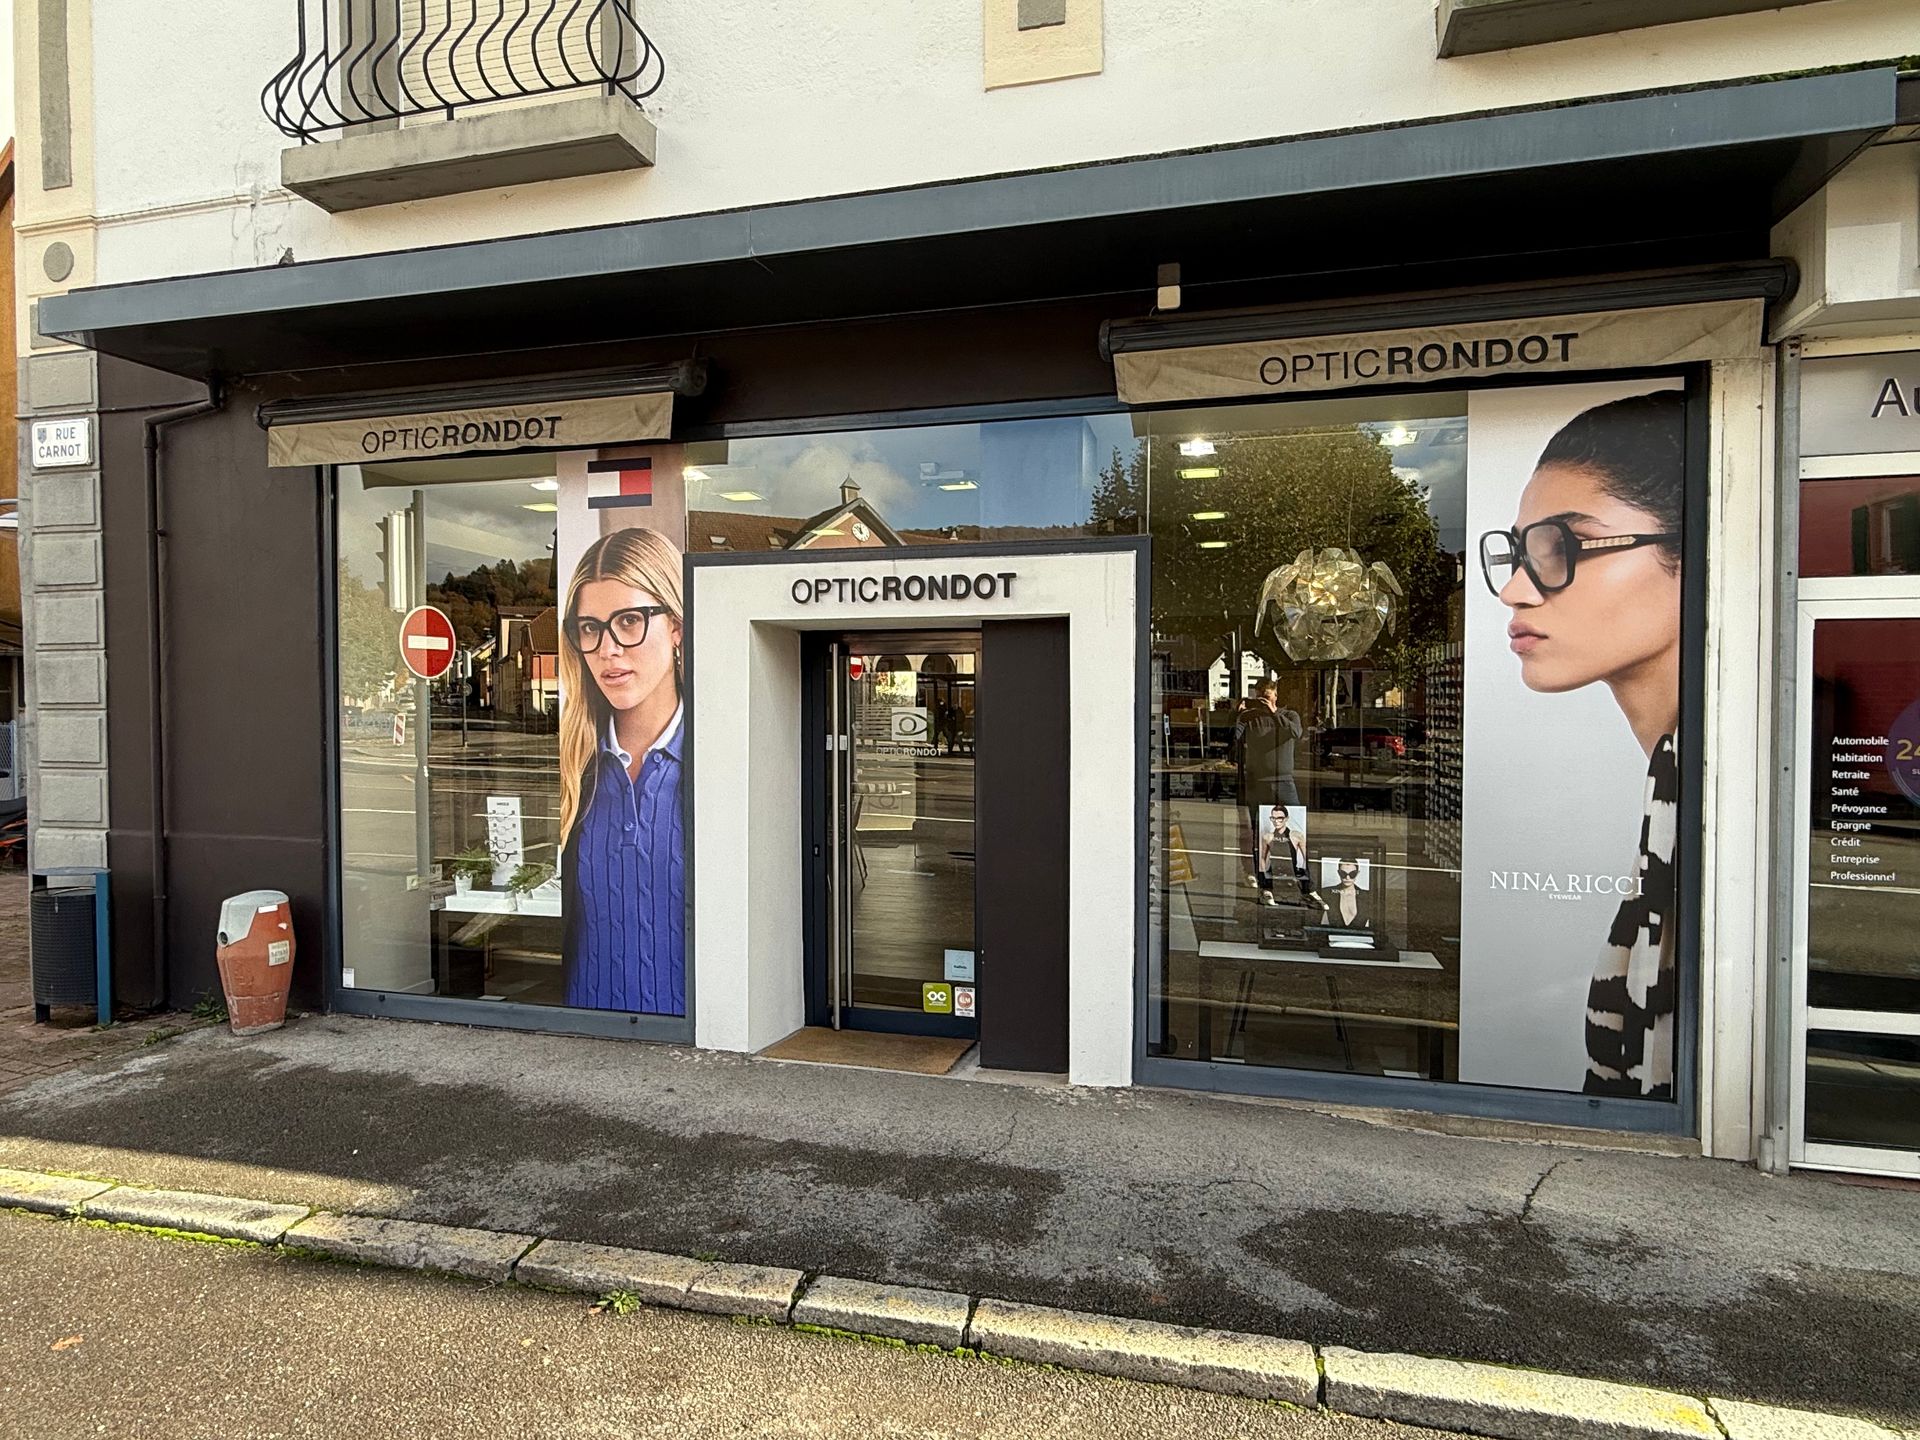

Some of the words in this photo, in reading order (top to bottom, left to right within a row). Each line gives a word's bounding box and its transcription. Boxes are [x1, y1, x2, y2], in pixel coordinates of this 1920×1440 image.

[1259, 332, 1579, 386] OPTICRONDOT
[56, 426, 76, 440] RUE
[361, 416, 562, 454] OPTICRONDOT
[38, 443, 81, 458] CARNOT
[791, 572, 1017, 604] OPTICRONDOT
[1832, 736, 1890, 746] Automobile
[1832, 752, 1883, 763] Habitation
[1831, 769, 1871, 780] Retraite
[1831, 786, 1860, 797] Santé
[1831, 803, 1888, 816] Prévoyance
[1831, 820, 1872, 832] Epargne
[1830, 837, 1861, 847] Crédit
[1830, 854, 1881, 866] Entreprise
[1830, 871, 1896, 881] Professionnel
[1489, 870, 1560, 892] NINA
[1566, 874, 1645, 896] RICCI
[1548, 893, 1582, 901] EYEWEAR
